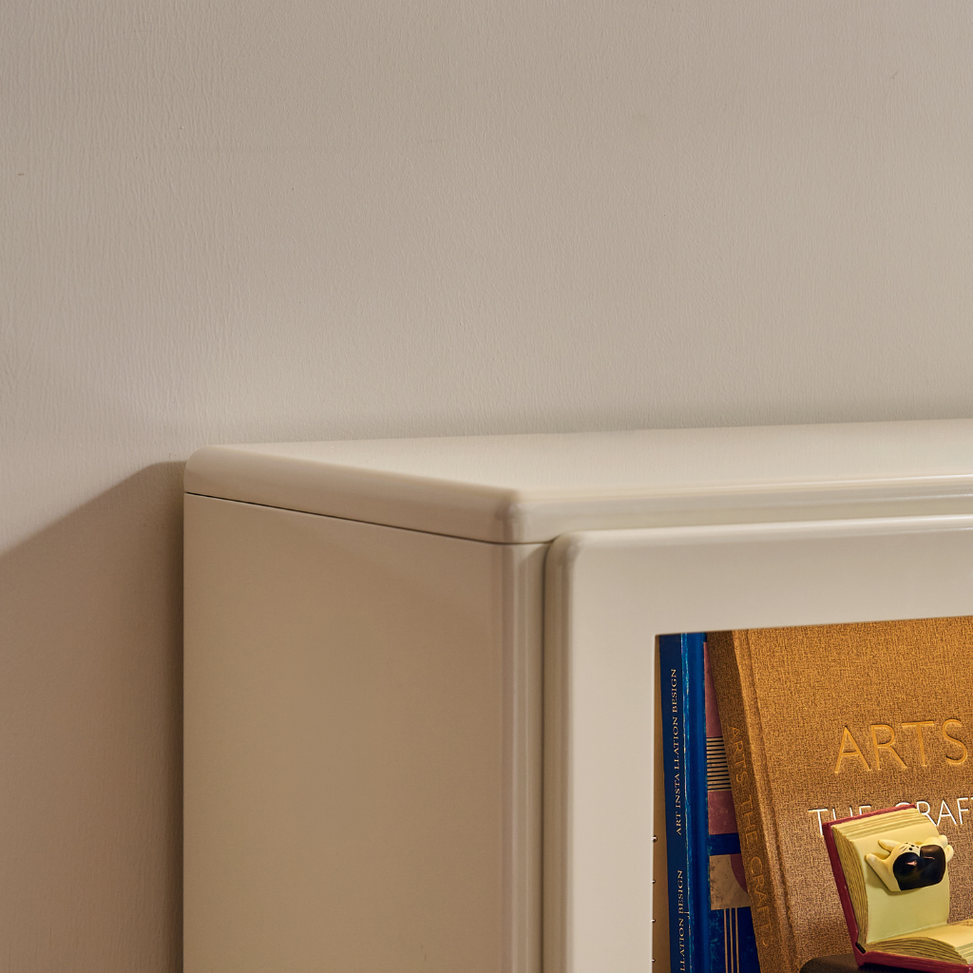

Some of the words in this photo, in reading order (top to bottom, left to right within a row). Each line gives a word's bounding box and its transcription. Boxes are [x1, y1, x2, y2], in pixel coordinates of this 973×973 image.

[730, 727, 748, 783] ARTS
[739, 794, 758, 844] THE
[834, 718, 968, 774] ARTS
